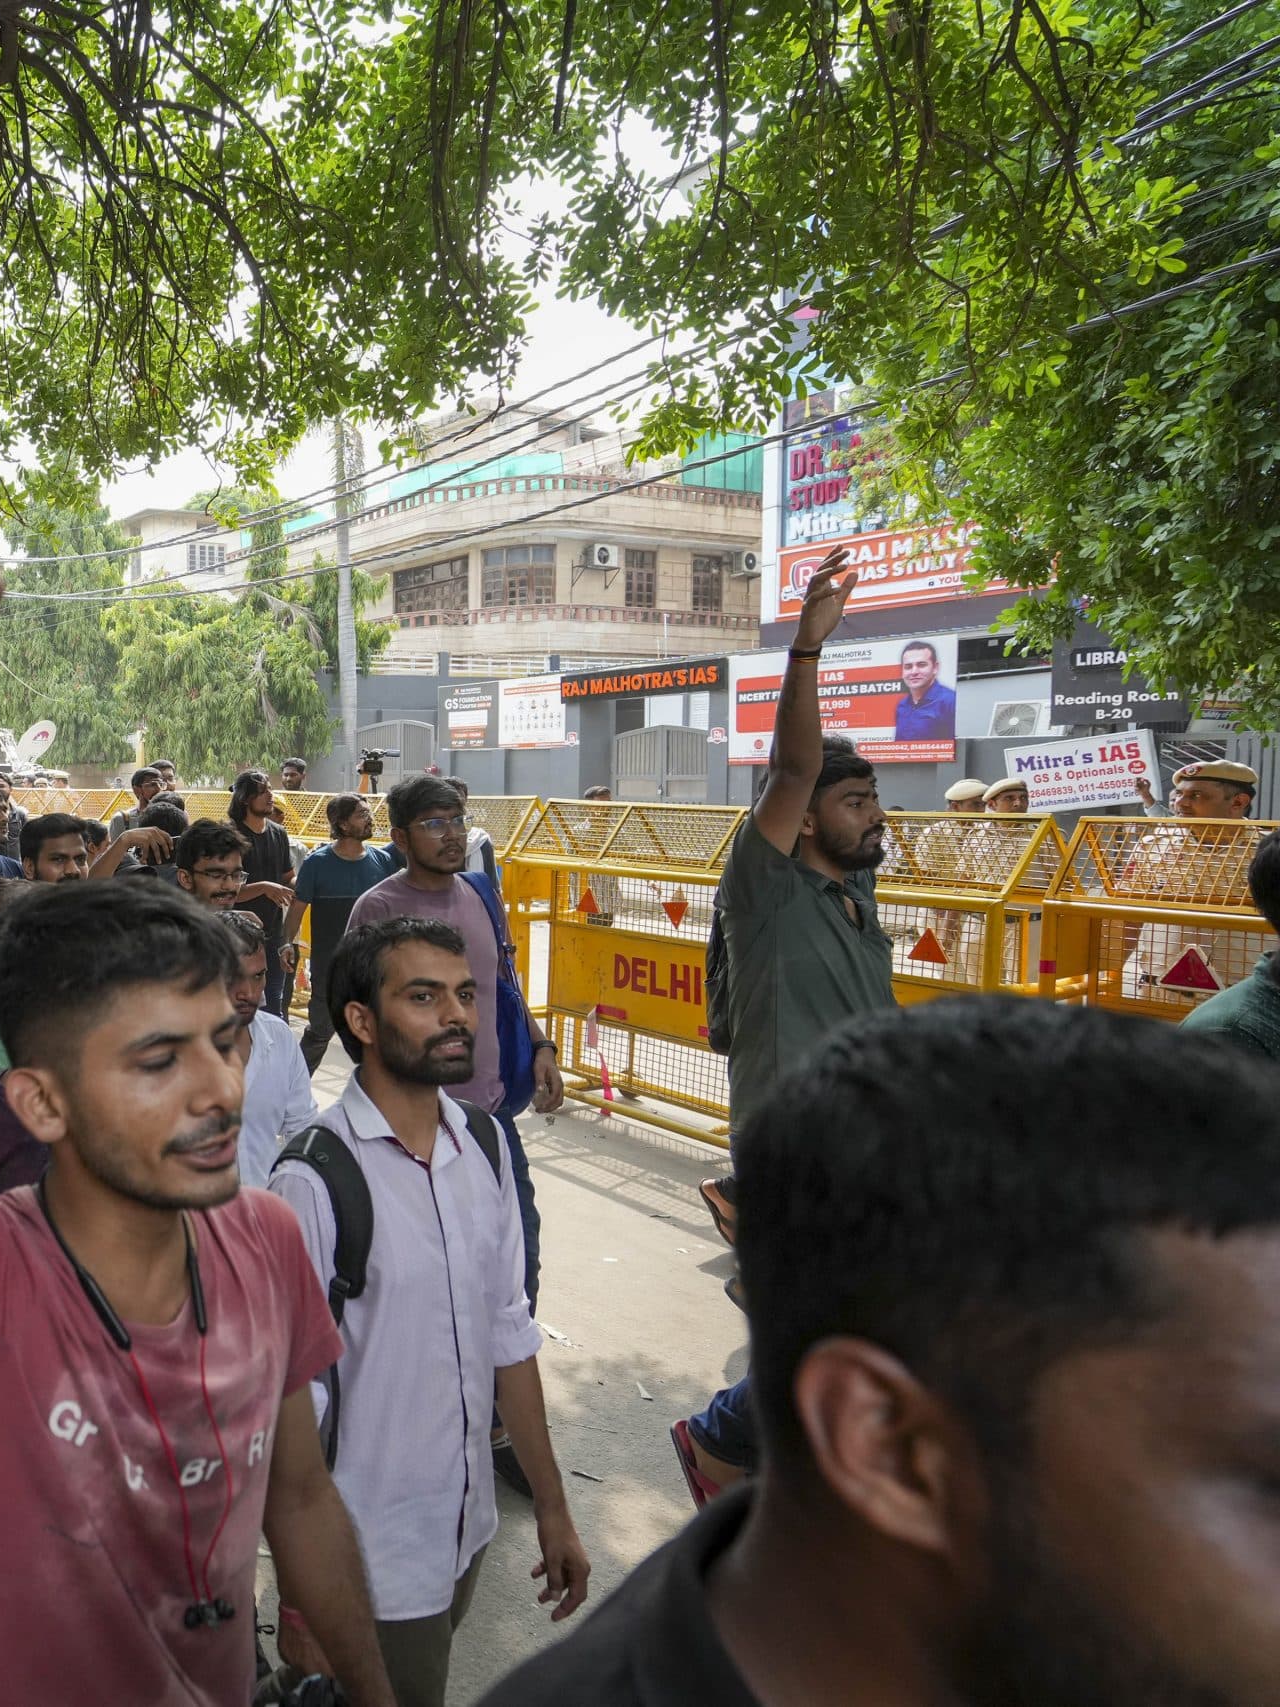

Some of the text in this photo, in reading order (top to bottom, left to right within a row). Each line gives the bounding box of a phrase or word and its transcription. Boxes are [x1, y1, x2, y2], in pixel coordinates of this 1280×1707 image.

[789, 476, 852, 511] STUDY
[844, 541, 887, 566] RAJ
[856, 562, 889, 582] IAS
[892, 553, 956, 577] STUDY
[938, 573, 963, 585] YOU
[1076, 651, 1141, 667] LIBRA
[561, 677, 588, 697] RAJ
[590, 669, 687, 695] MALHOTRA'S
[690, 665, 719, 685] IAS
[824, 671, 845, 682] IAS
[739, 690, 771, 703] NCERT
[860, 681, 901, 694] BATCH
[1054, 691, 1123, 706] Reading
[444, 697, 459, 710] GS
[1095, 707, 1133, 720] B-20
[827, 719, 848, 729] AUG
[1015, 742, 1141, 773] Mitra's IAS
[1033, 764, 1125, 784] GS & Optionals
[1081, 794, 1096, 803] IAS
[1098, 791, 1121, 802] Study
[613, 952, 703, 1006] DELHI
[48, 1400, 99, 1447] Gr
[180, 1457, 223, 1487] Br
